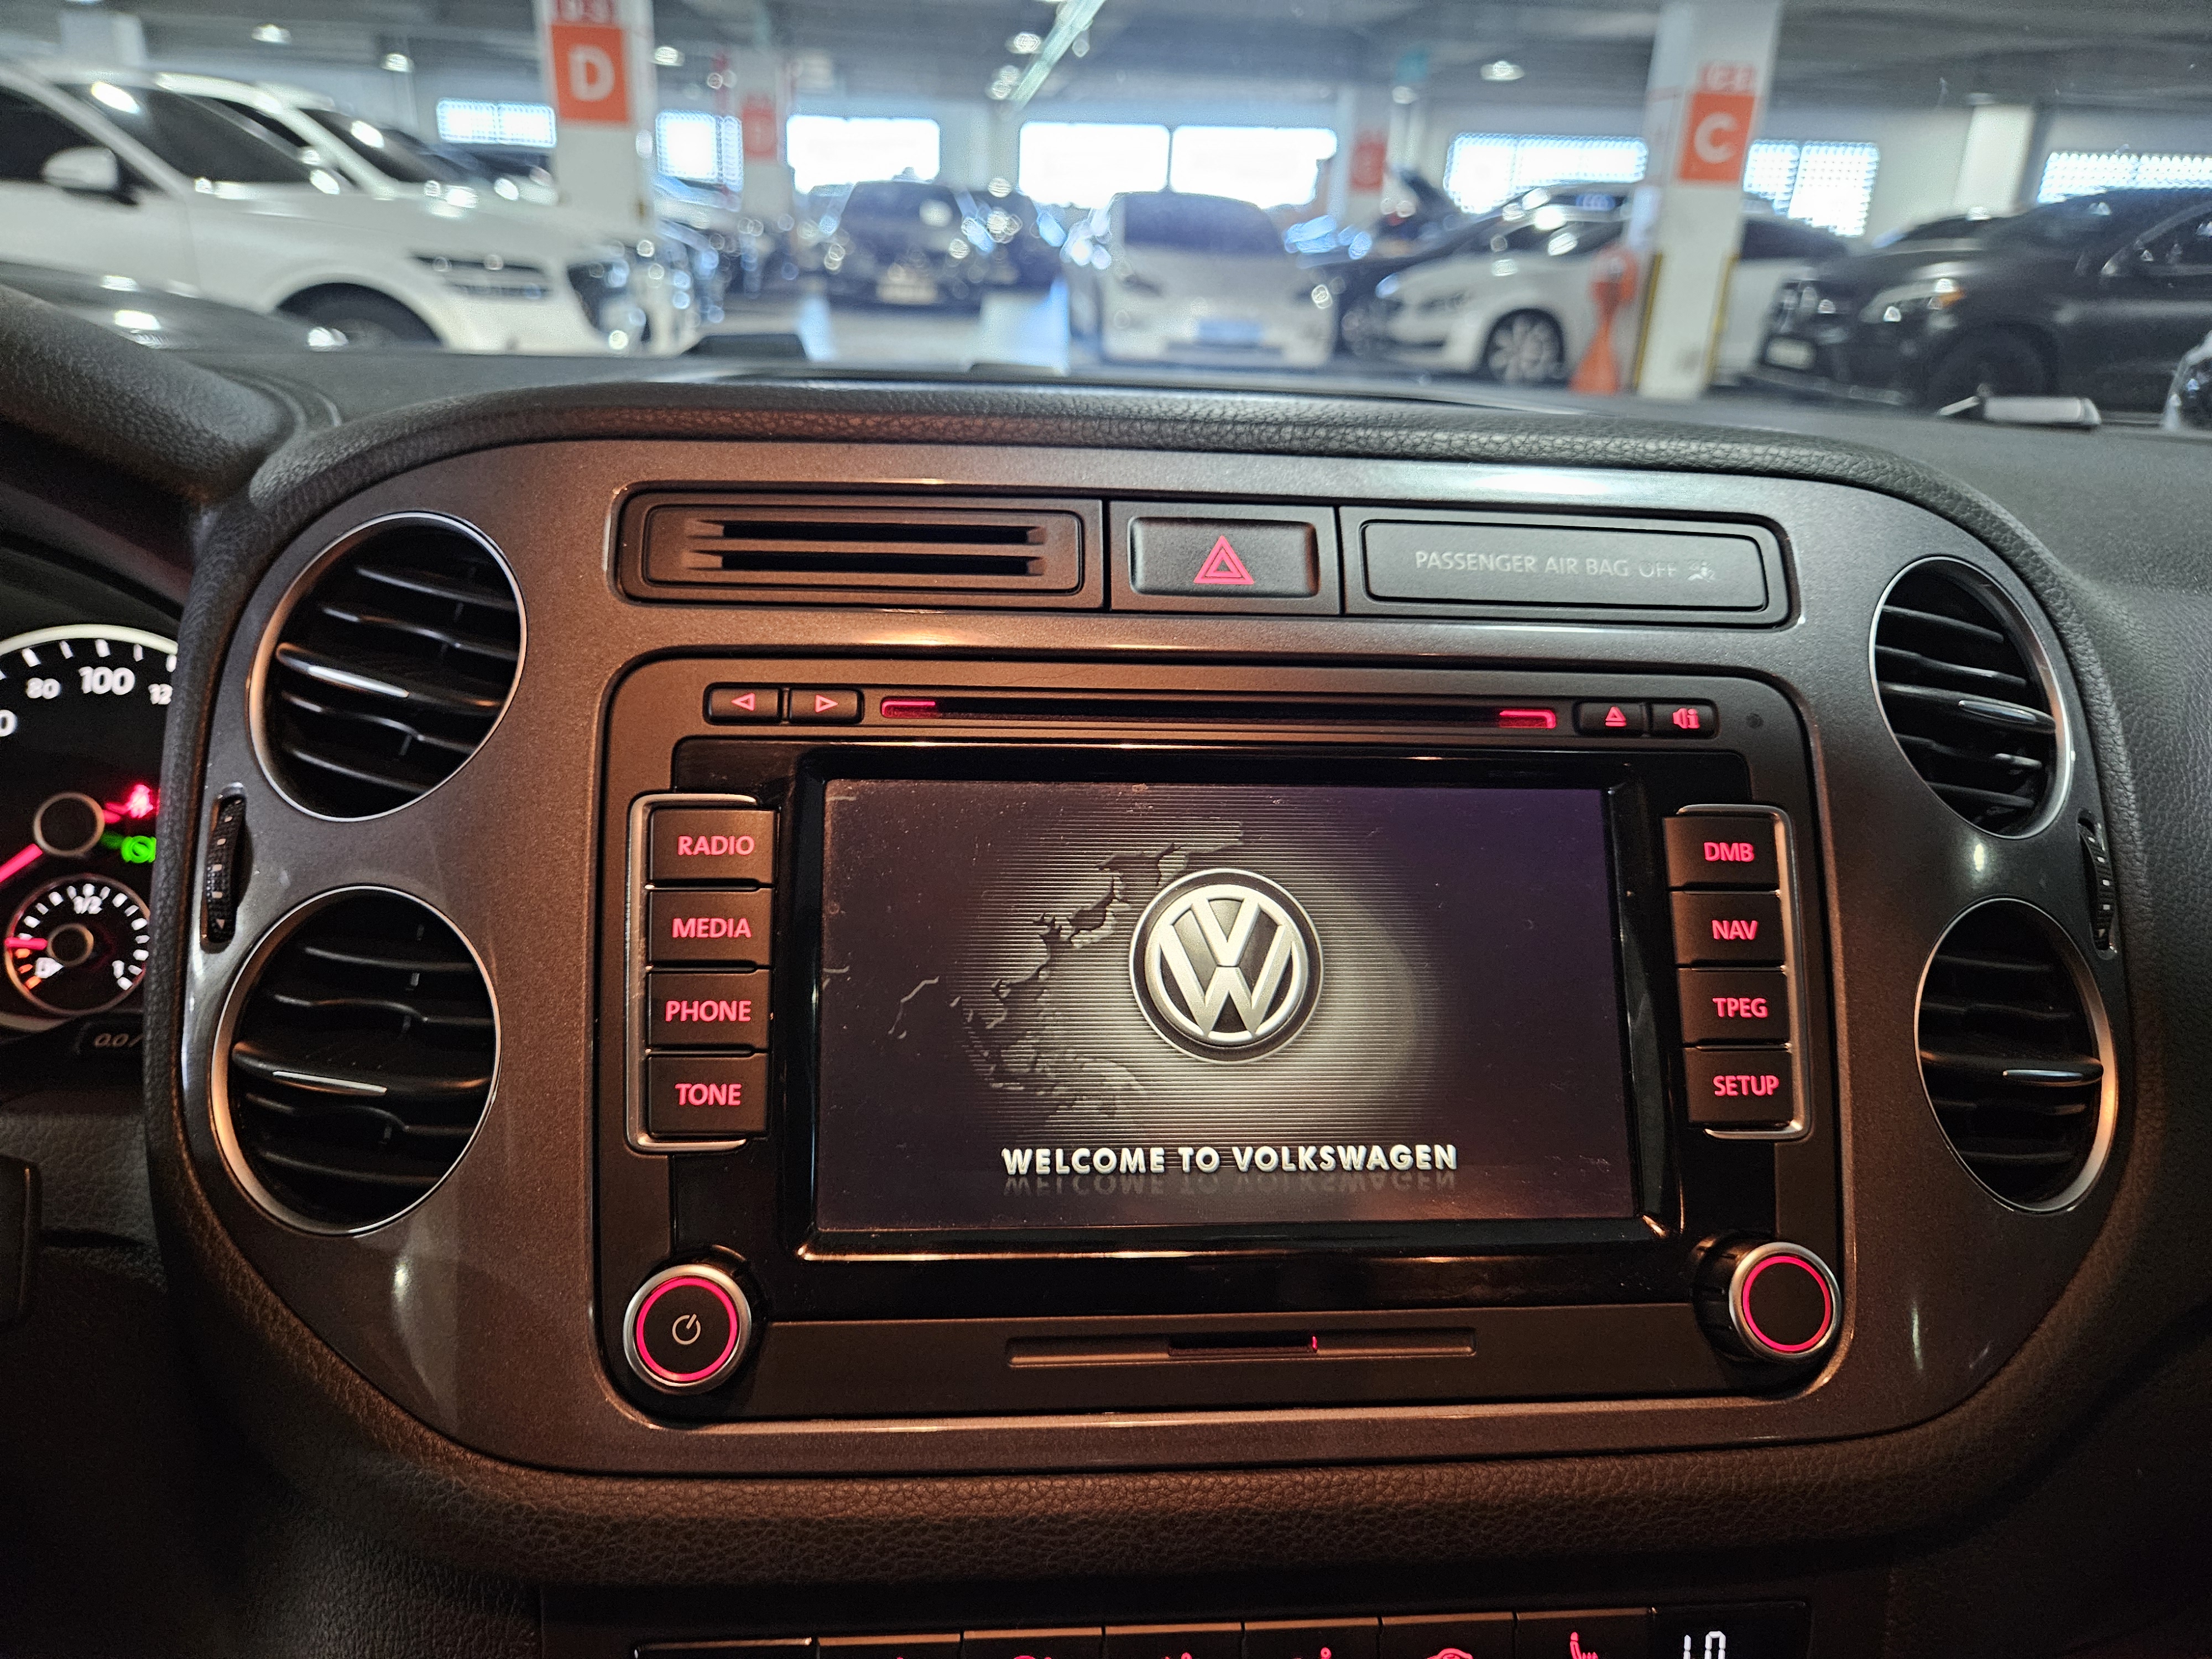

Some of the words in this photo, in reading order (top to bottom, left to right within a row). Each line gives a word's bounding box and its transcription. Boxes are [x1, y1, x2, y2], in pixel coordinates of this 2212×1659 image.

[569, 45, 615, 101] D
[1695, 112, 1739, 164] C
[1415, 551, 1537, 573] PASSENGER
[1544, 557, 1579, 575] AIR
[1585, 559, 1629, 577] BAG
[1638, 561, 1677, 578] OFF
[26, 677, 61, 700] 80
[79, 666, 135, 695] 100
[148, 684, 173, 705] 12
[677, 835, 755, 856] RADIO
[1703, 842, 1755, 862] DMB
[671, 917, 753, 939] MEDIA
[1712, 920, 1759, 940] NAV
[665, 999, 752, 1023] PHONE
[1712, 997, 1768, 1019] TPEG
[674, 1083, 742, 1106] TONE
[1713, 1074, 1779, 1097] SETUP
[1001, 1147, 1165, 1175] WELCOME
[1177, 1146, 1220, 1173] TO
[1231, 1144, 1458, 1173] VOLKSWAGEN
